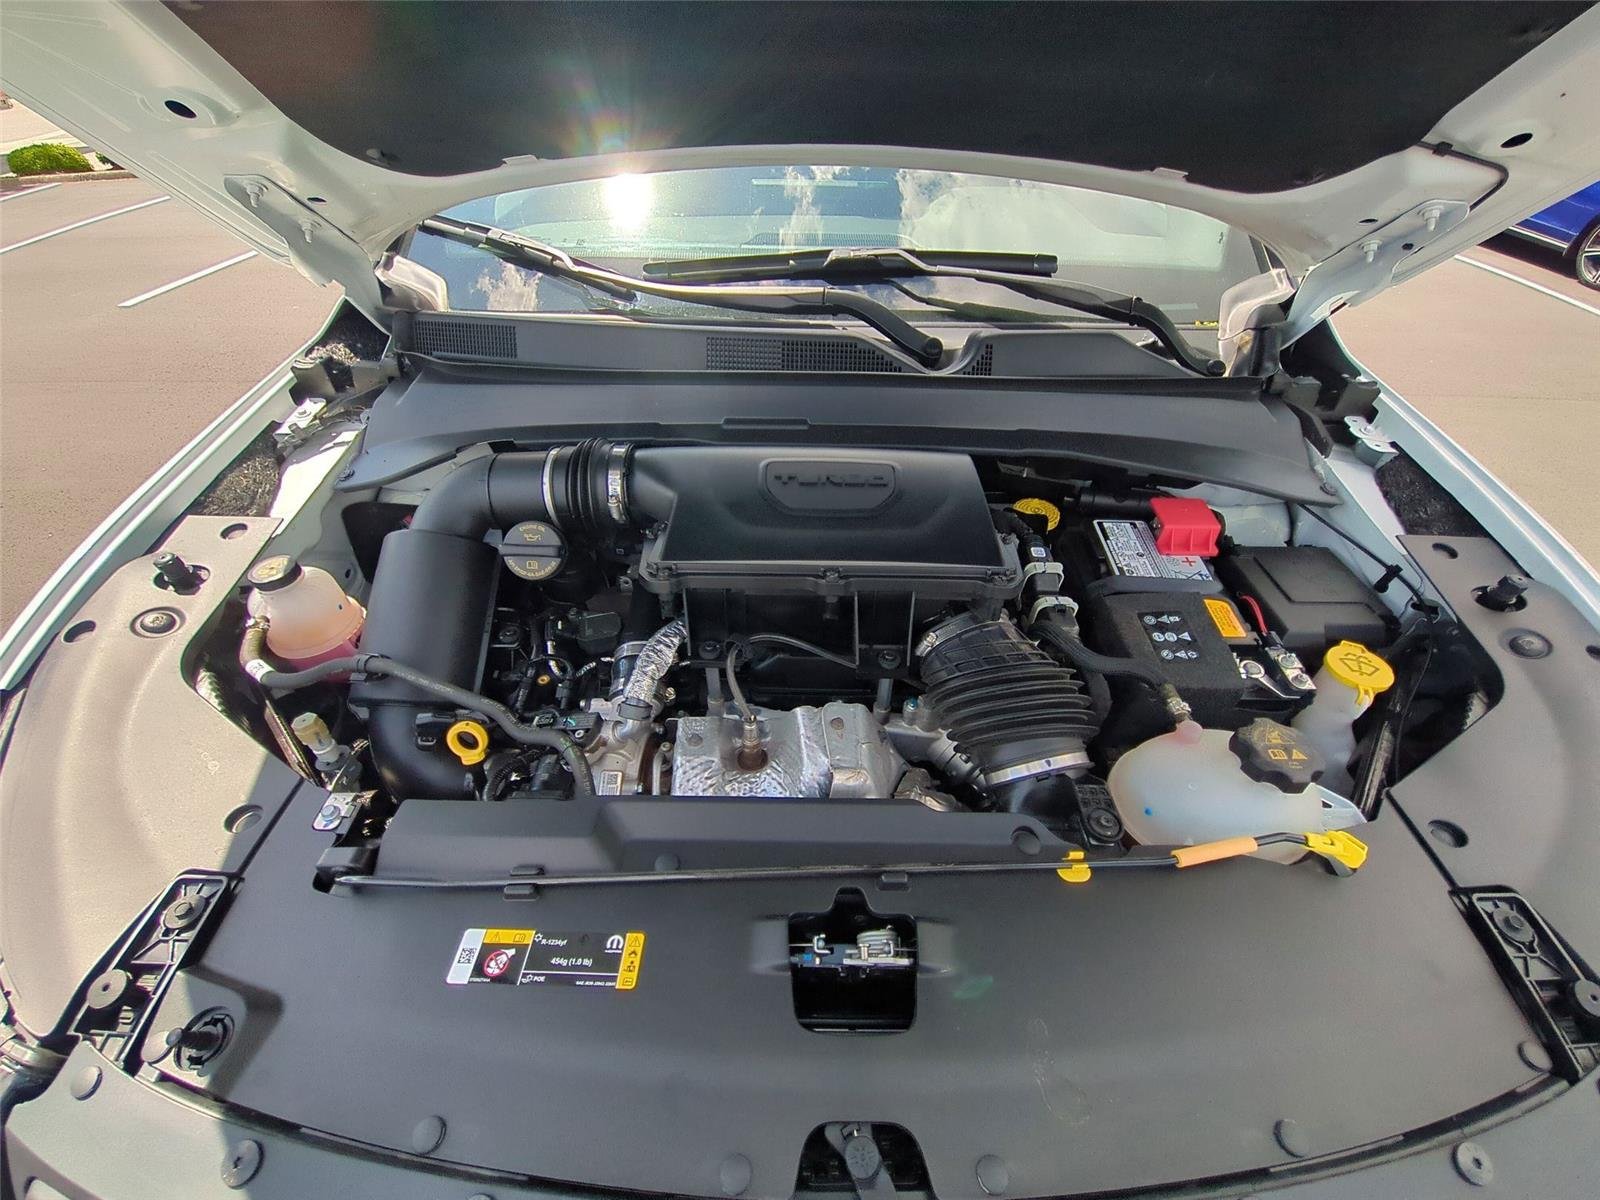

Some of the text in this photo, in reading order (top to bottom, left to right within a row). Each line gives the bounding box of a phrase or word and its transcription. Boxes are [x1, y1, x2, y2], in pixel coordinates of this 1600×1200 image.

[550, 957, 593, 967] 454g (1.0 lb)
